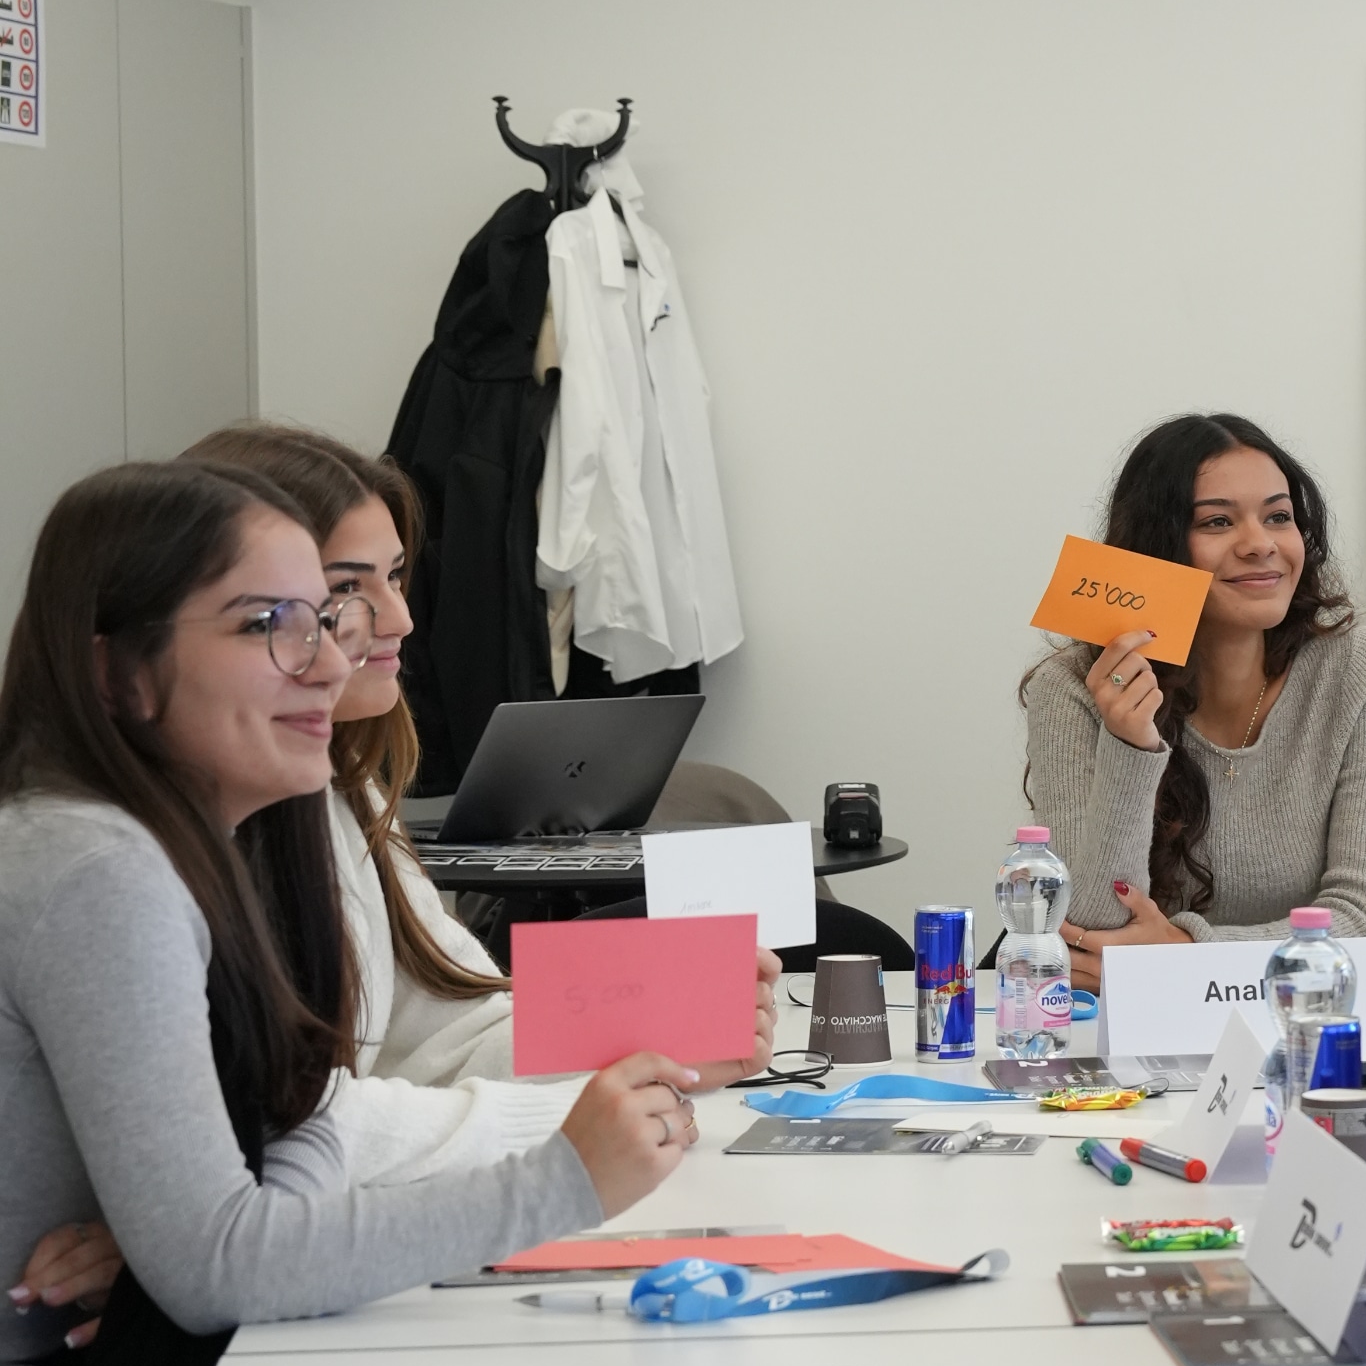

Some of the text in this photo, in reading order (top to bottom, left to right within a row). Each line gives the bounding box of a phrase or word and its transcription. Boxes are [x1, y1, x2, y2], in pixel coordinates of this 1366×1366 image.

[1071, 577, 1145, 610] 25'000
[921, 962, 975, 981] Red Bul
[1204, 978, 1265, 1002] Anal
[1042, 995, 1068, 1006] nove
[831, 1015, 882, 1026] MACCHIATO
